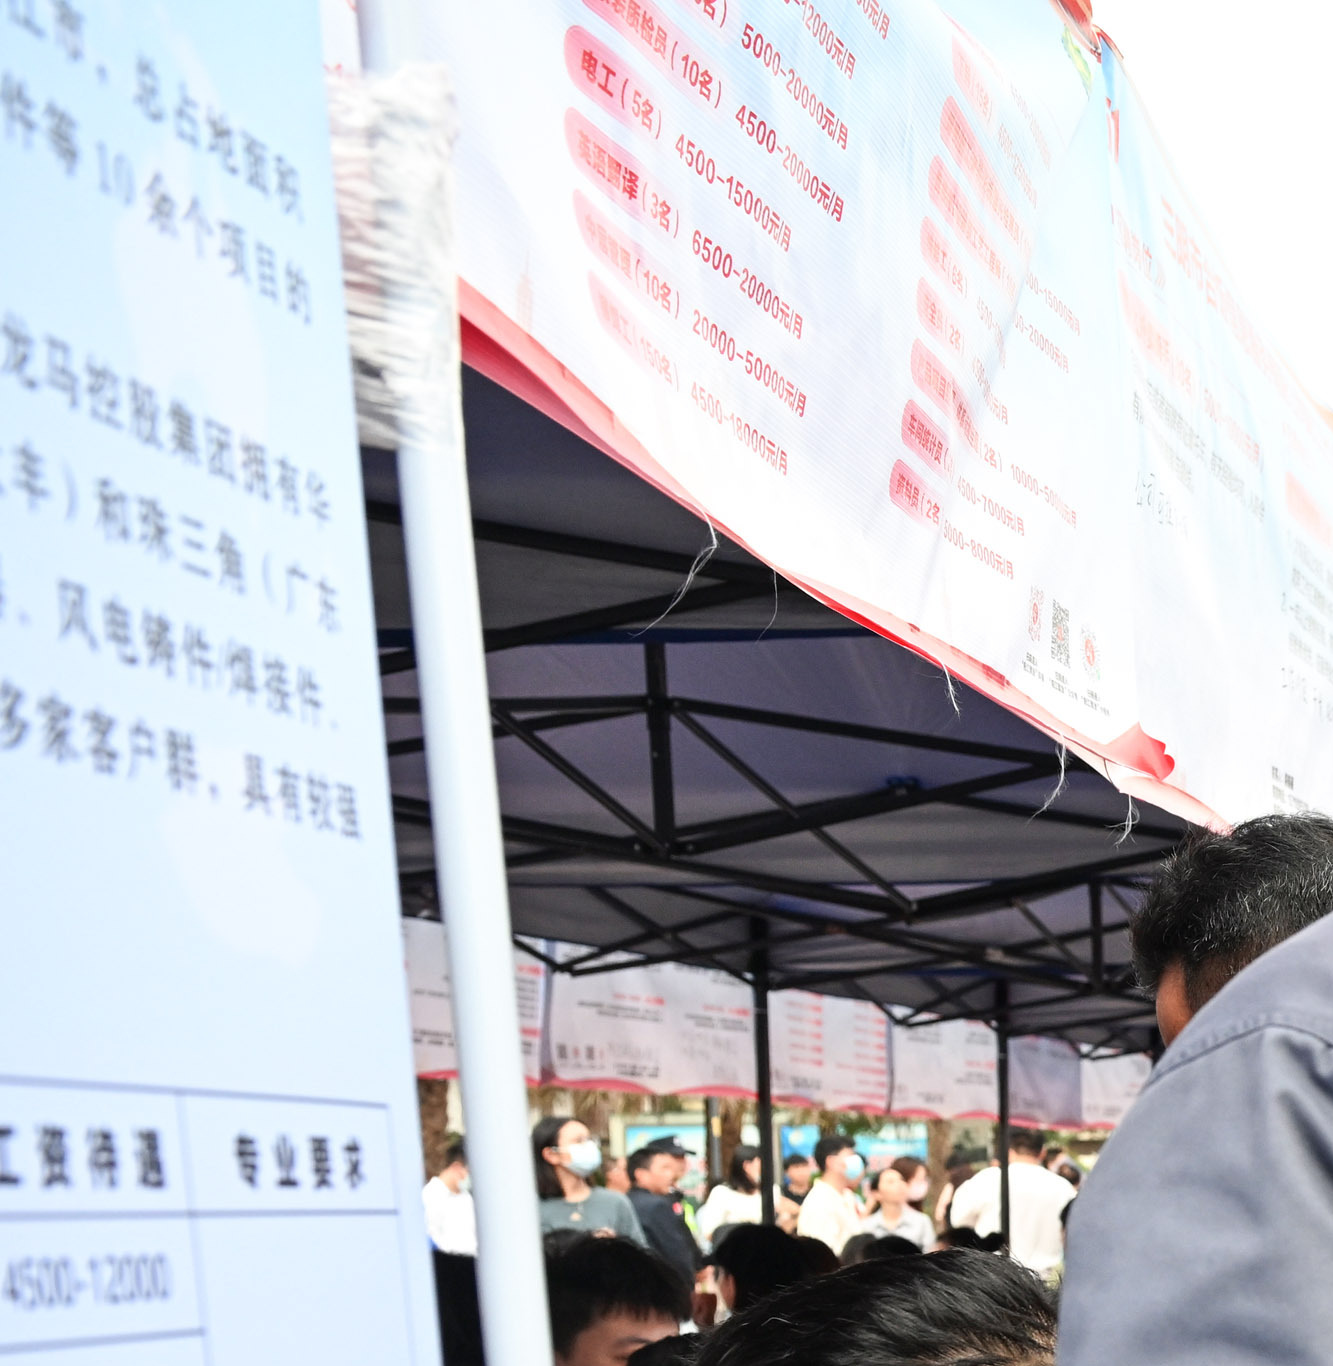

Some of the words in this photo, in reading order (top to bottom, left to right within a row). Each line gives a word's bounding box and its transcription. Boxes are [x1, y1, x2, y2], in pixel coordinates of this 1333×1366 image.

[675, 133, 792, 252] 4500-15000元/月
[735, 104, 844, 222] 4500-20000元/月
[691, 229, 804, 341] 6500-20000元/月
[692, 308, 808, 419] 20000-50000元/月
[233, 1130, 367, 1192] 专业要求
[2, 1251, 174, 1312] 4500-12000
